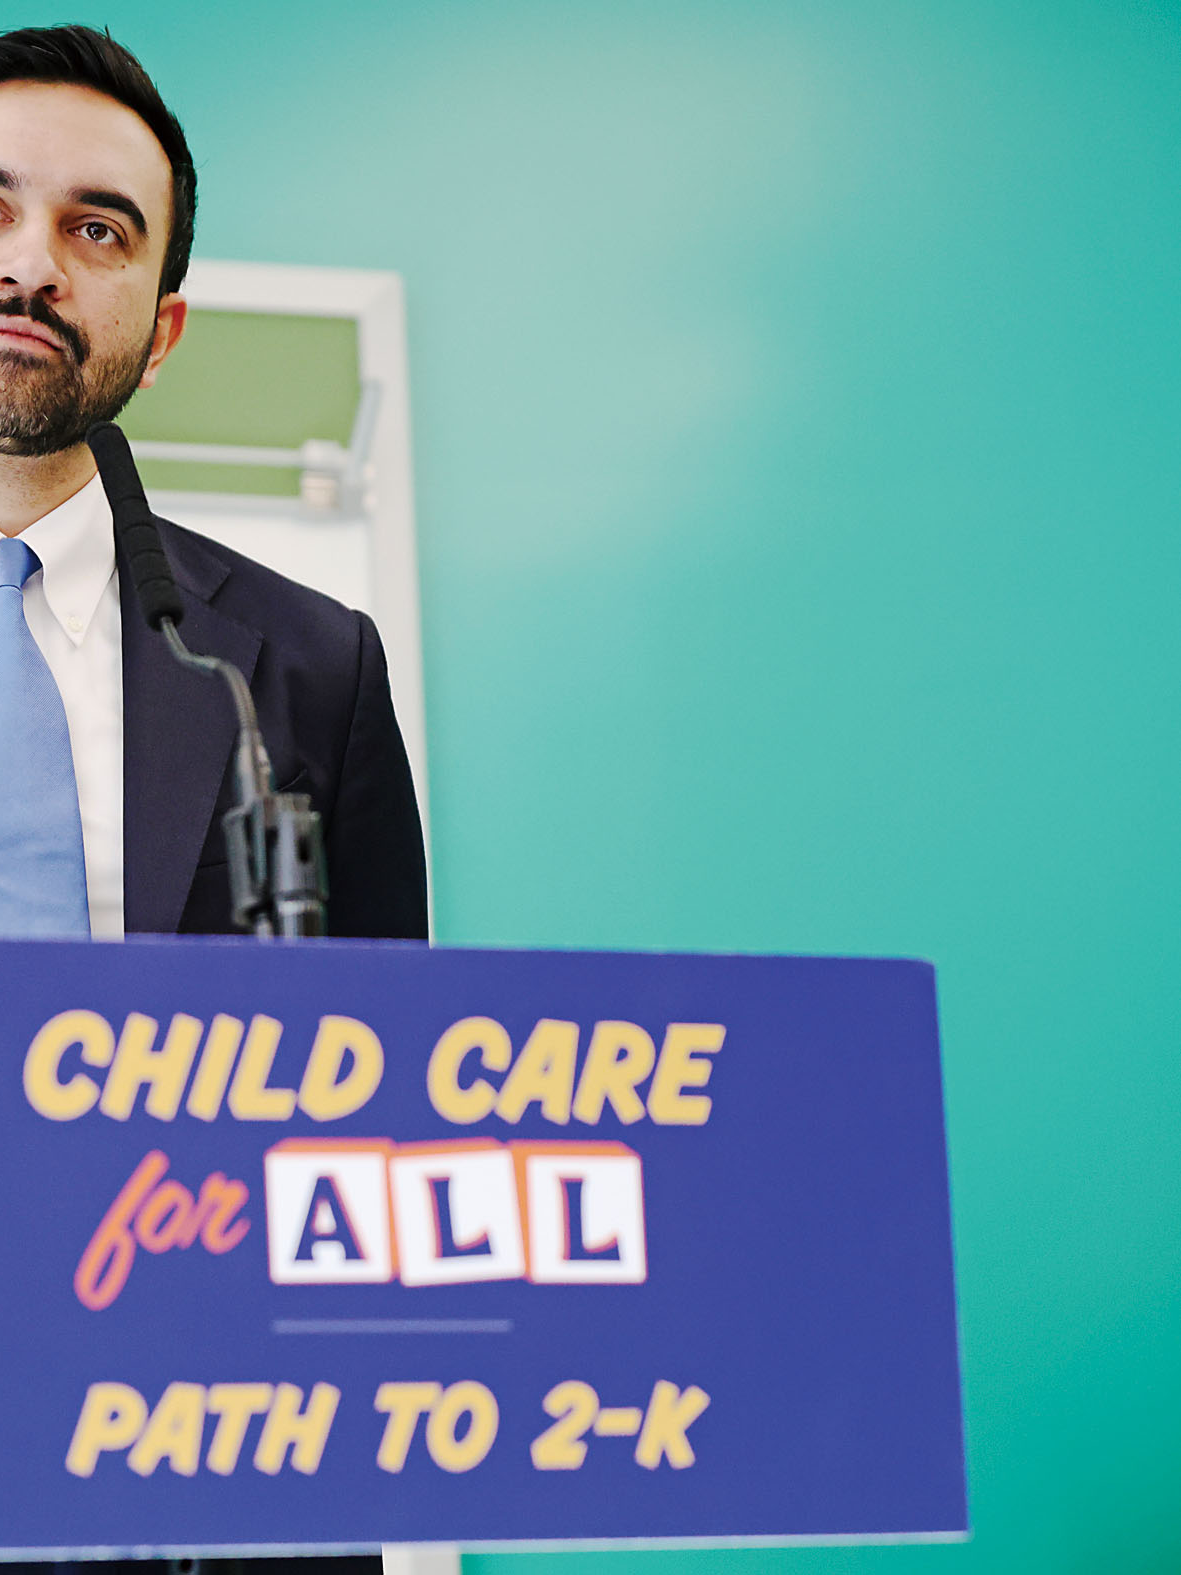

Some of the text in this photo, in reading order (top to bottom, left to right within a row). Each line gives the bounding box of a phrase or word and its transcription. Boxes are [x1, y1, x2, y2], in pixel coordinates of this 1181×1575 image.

[22, 1009, 726, 1125] CHILD CARE
[74, 1149, 623, 1310] for ALL
[65, 1379, 711, 1477] PATH TO 2-K
